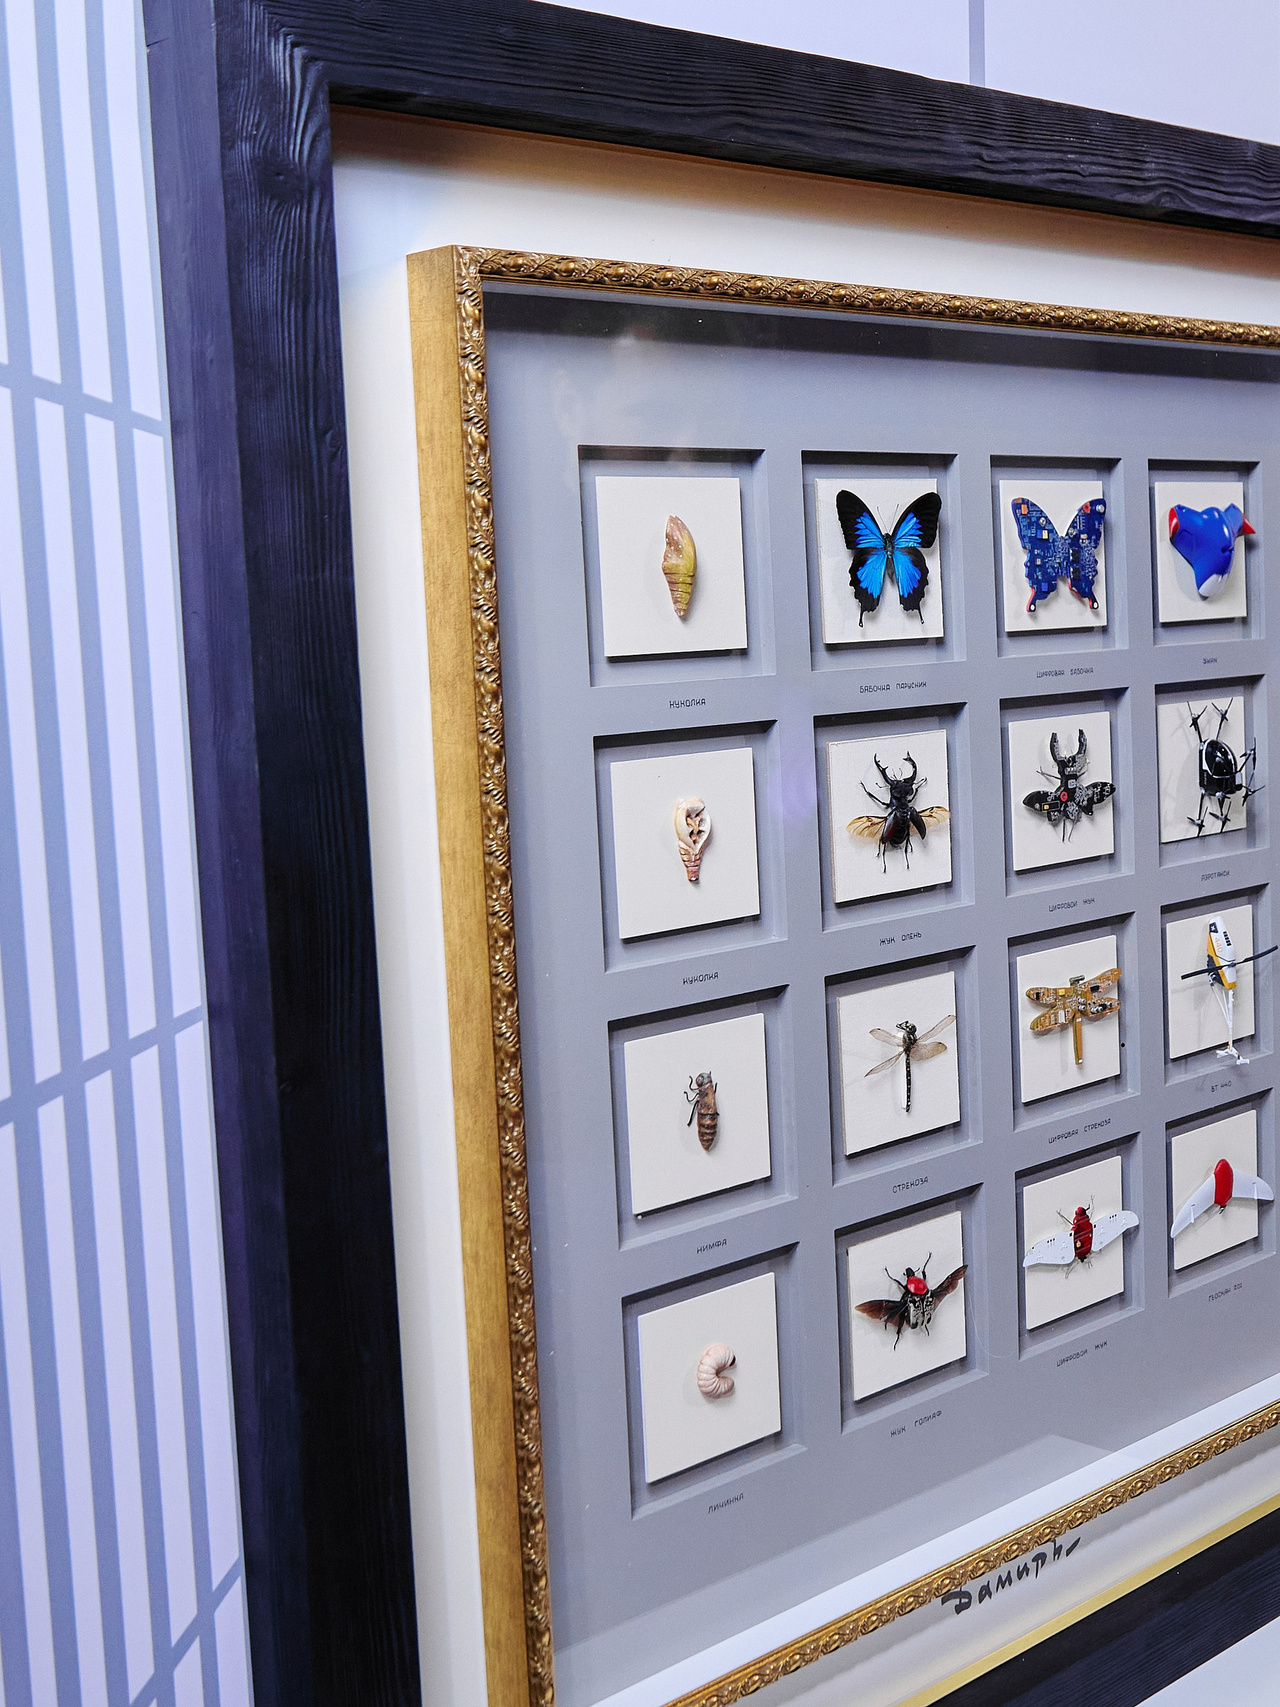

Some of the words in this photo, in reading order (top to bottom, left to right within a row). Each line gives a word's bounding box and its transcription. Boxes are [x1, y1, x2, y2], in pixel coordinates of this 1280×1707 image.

[1070, 667, 1094, 676] БАБОЧКА
[859, 683, 891, 694] БАБОЧКА
[895, 681, 927, 690] ПАРУСНИК
[668, 697, 706, 709] КУКОЛКА
[1082, 897, 1096, 905] ЖУК
[879, 936, 896, 947] ЖУК
[901, 932, 922, 942] ОЛЕНЬ
[682, 971, 719, 985] КУКОЛКА
[1048, 1128, 1079, 1144] ЦИФРОВАЯ
[1083, 1117, 1111, 1133] СТРЕКОЗА
[892, 1176, 929, 1194] СТРЕКОЗА
[696, 1238, 727, 1255] НИМФА
[1094, 1340, 1108, 1351] ЖУК
[890, 1425, 907, 1438] ЖУК
[914, 1410, 943, 1428] ГОЛИАФ
[707, 1492, 744, 1514] ЛИЧИНКА
